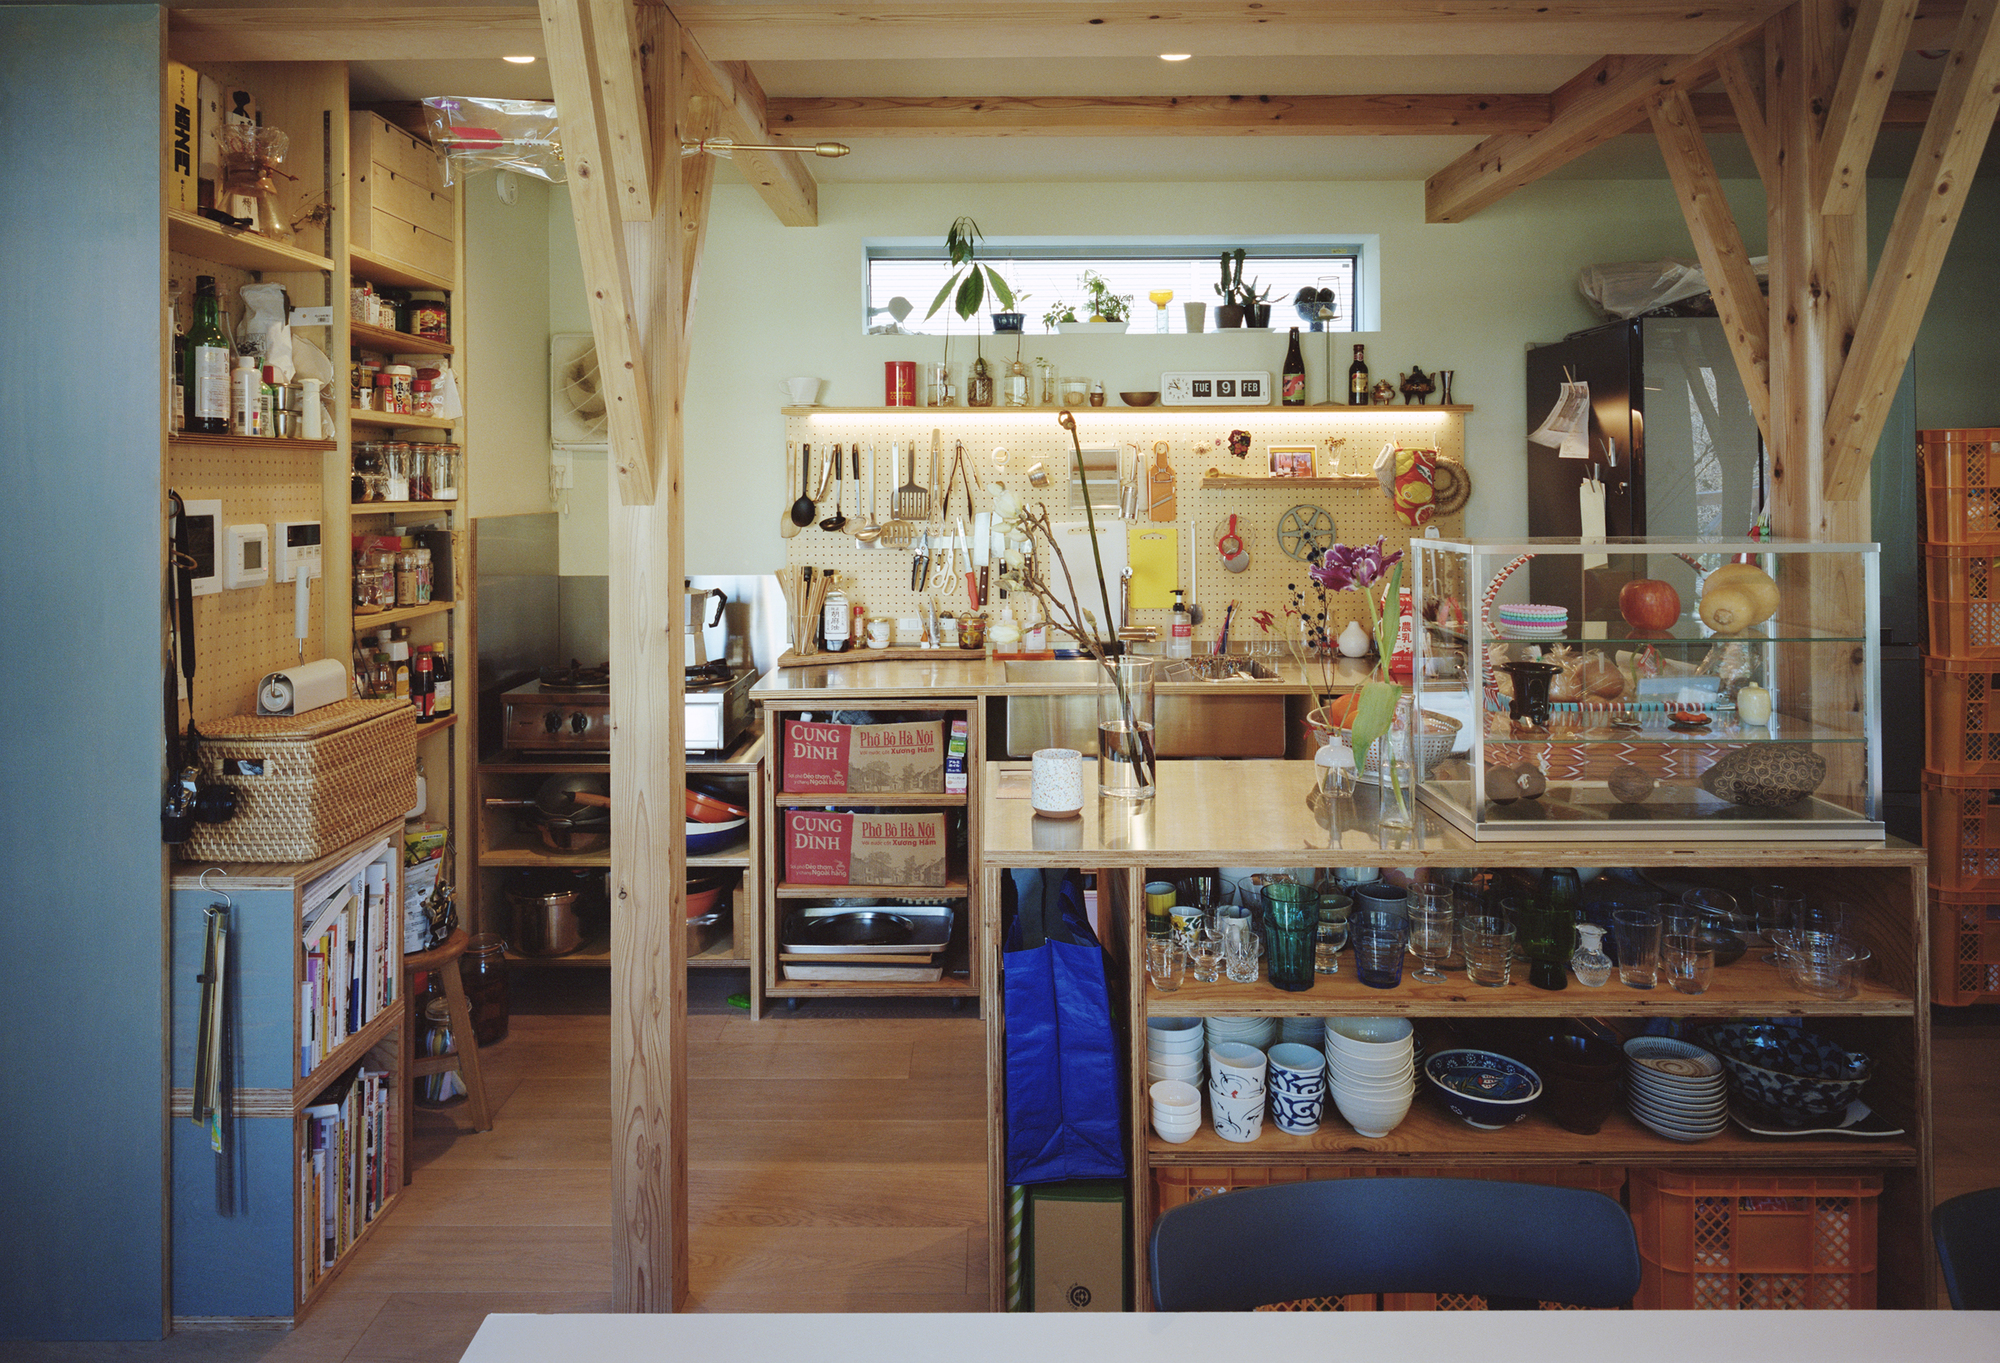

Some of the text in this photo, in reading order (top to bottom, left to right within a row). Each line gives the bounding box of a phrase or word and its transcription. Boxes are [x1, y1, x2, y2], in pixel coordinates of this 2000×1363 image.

[1194, 382, 1210, 393] TUE
[1221, 381, 1231, 394] 9
[1243, 382, 1258, 392] FEB
[791, 724, 840, 743] CUNG
[883, 730, 896, 746] Bò
[899, 730, 913, 745] Hà
[916, 729, 934, 747] Nội
[793, 742, 838, 760] ĐÌNH
[792, 815, 842, 833] CUNG
[885, 822, 897, 837] Bò
[900, 822, 915, 837] Hà
[918, 821, 935, 838] Nội
[795, 832, 840, 850] ĐÌNH
